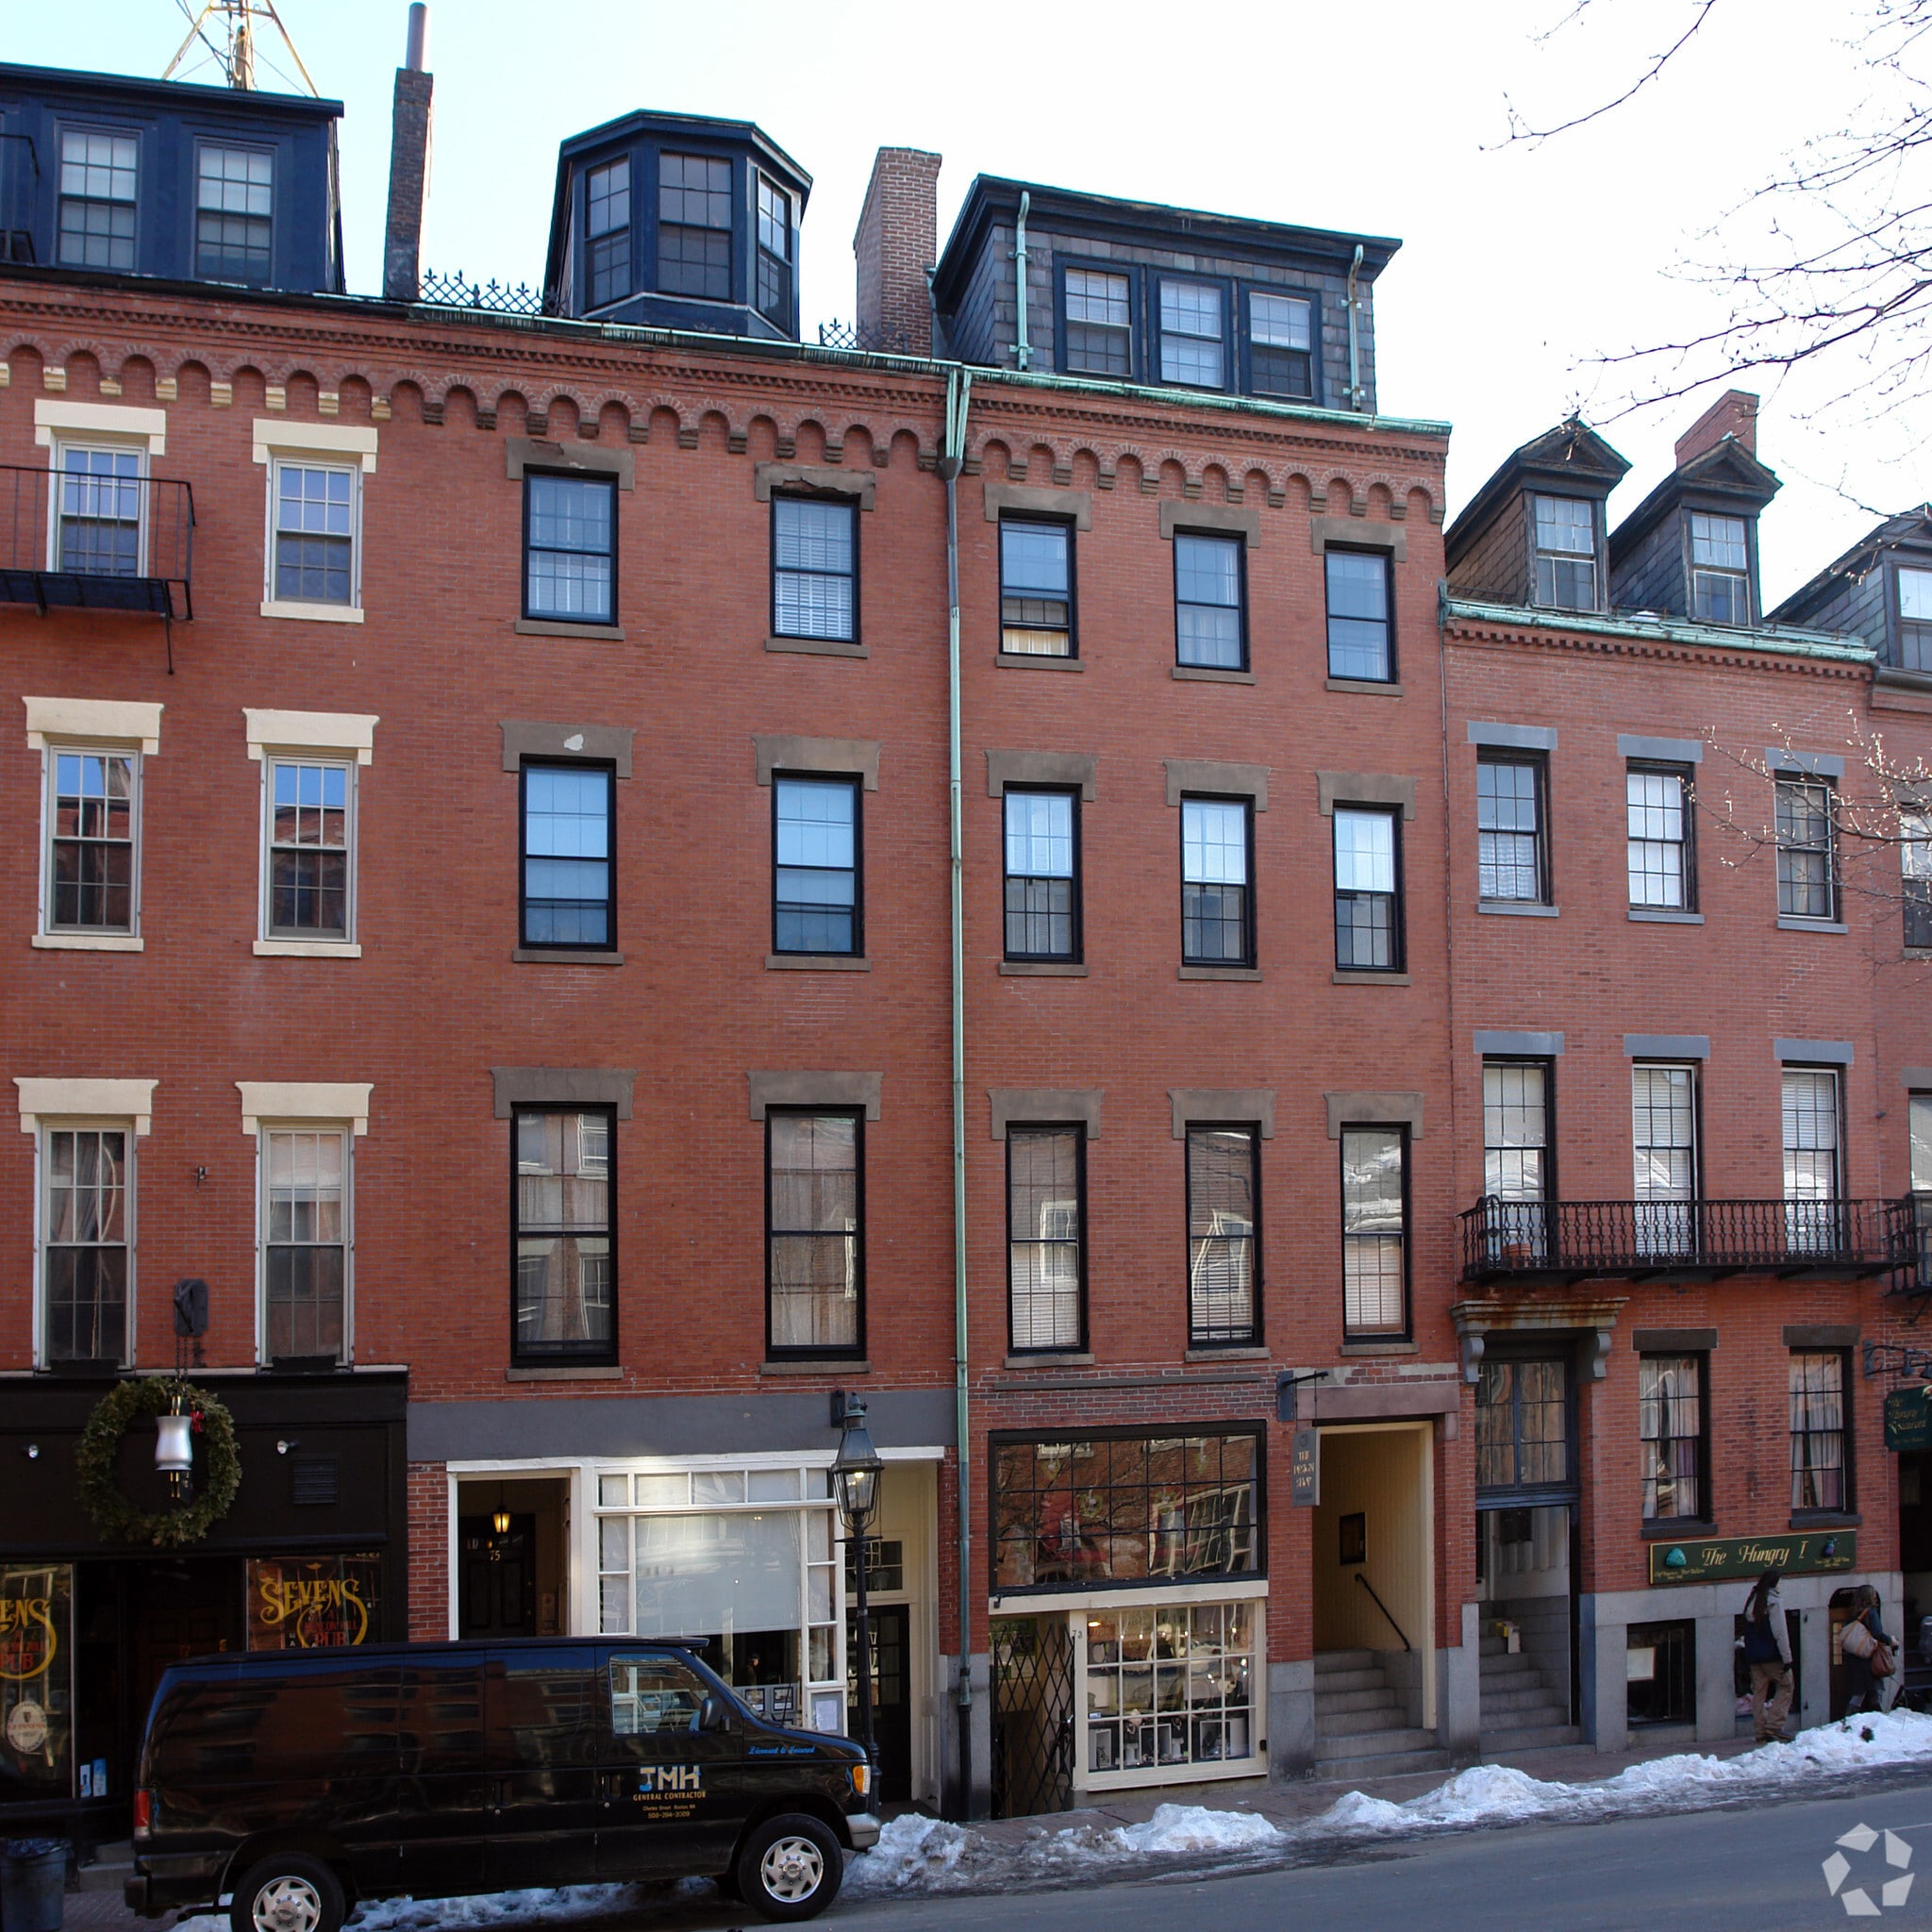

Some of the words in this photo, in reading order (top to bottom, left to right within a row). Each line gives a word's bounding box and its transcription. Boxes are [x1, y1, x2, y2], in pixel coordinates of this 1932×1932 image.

[489, 1549, 501, 1562] 75
[1701, 1546, 1728, 1567] The
[1737, 1543, 1790, 1568] Hungry
[1798, 1540, 1808, 1559] I
[259, 1577, 366, 1626] SEVENS
[315, 1631, 347, 1647] PUB
[632, 1793, 662, 1802] GENERAL
[664, 1790, 707, 1801] CONTRACTOR
